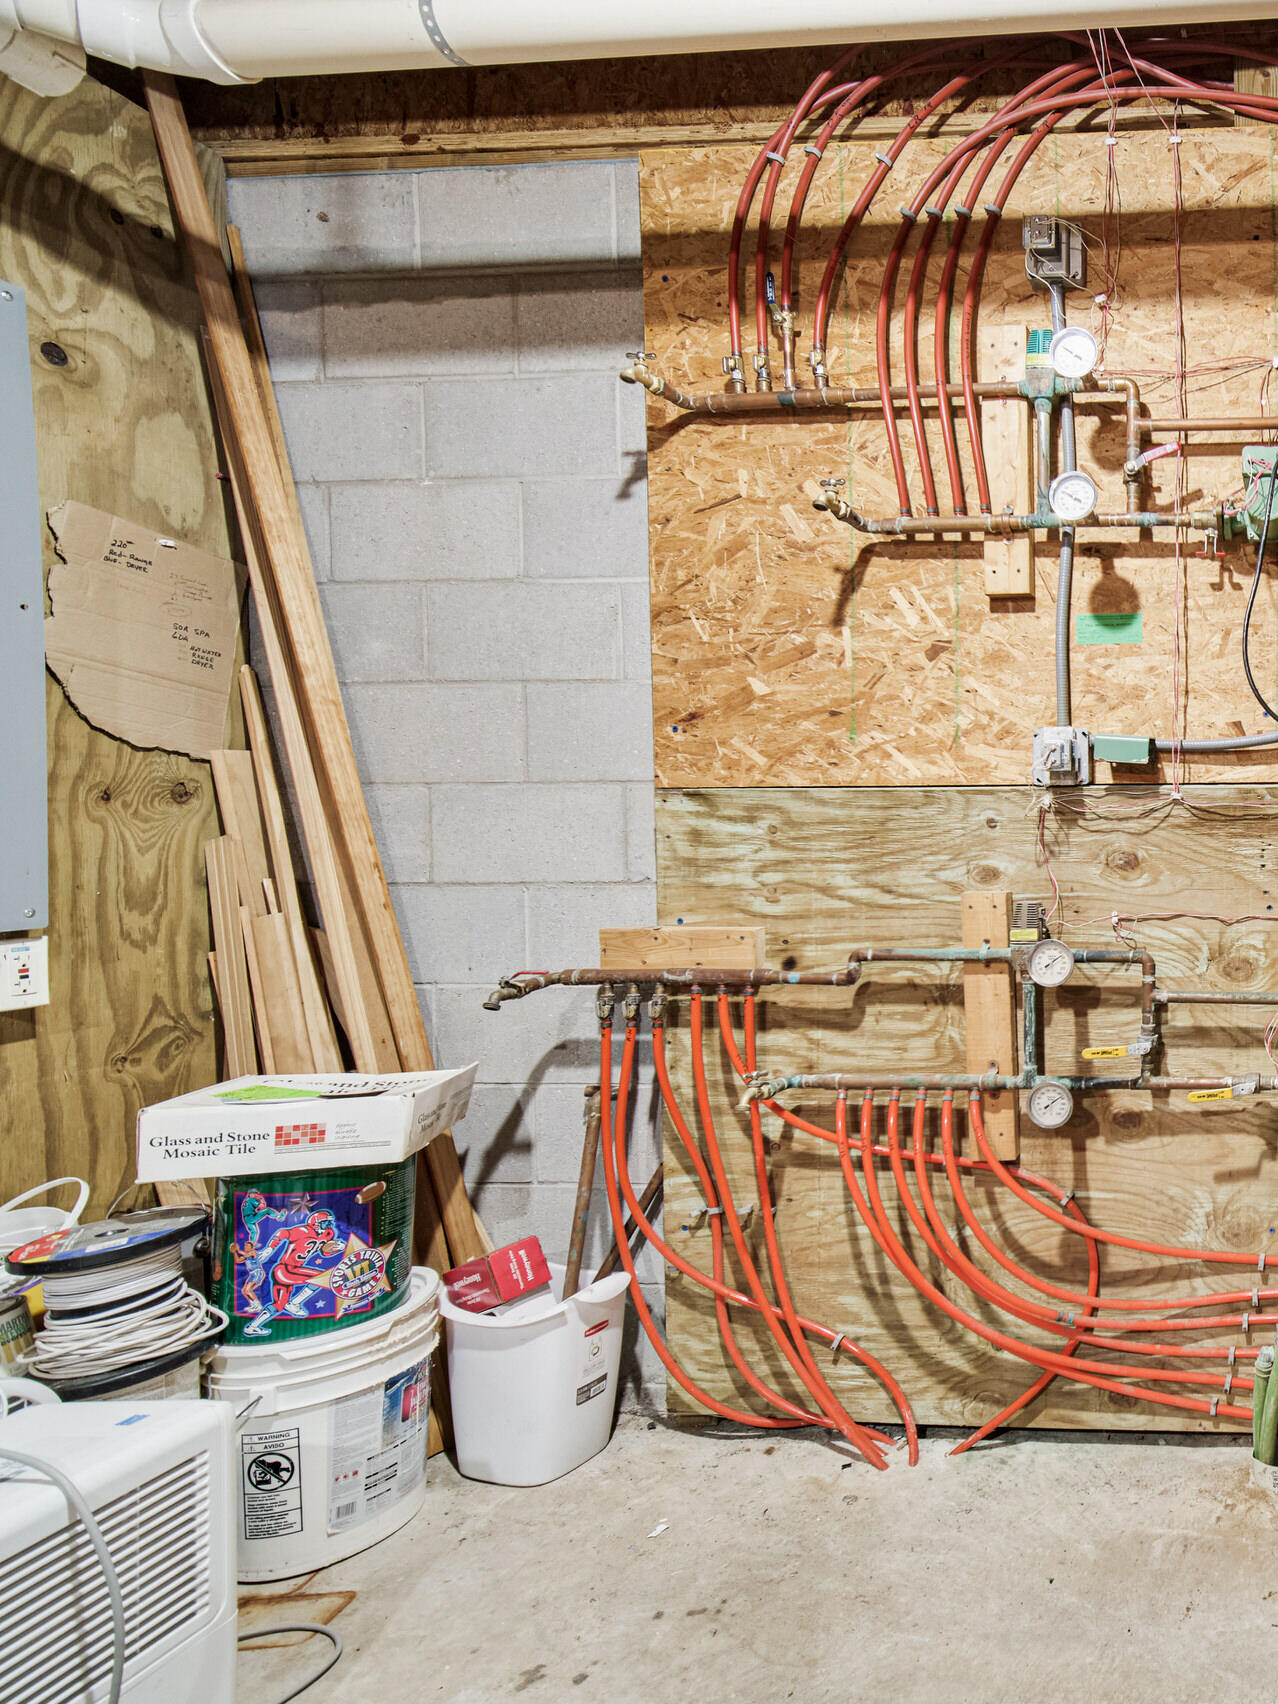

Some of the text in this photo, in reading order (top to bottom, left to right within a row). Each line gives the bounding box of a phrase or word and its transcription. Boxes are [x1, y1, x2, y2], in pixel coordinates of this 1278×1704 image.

[149, 1131, 270, 1148] Glass and Stone
[163, 1144, 256, 1160] Mosaic Tile
[333, 1254, 357, 1288] SPORTS
[360, 1250, 384, 1269] TRIVIA
[348, 1280, 377, 1297] GAME
[258, 1432, 290, 1441] WARNING
[263, 1442, 285, 1450] AVISO
